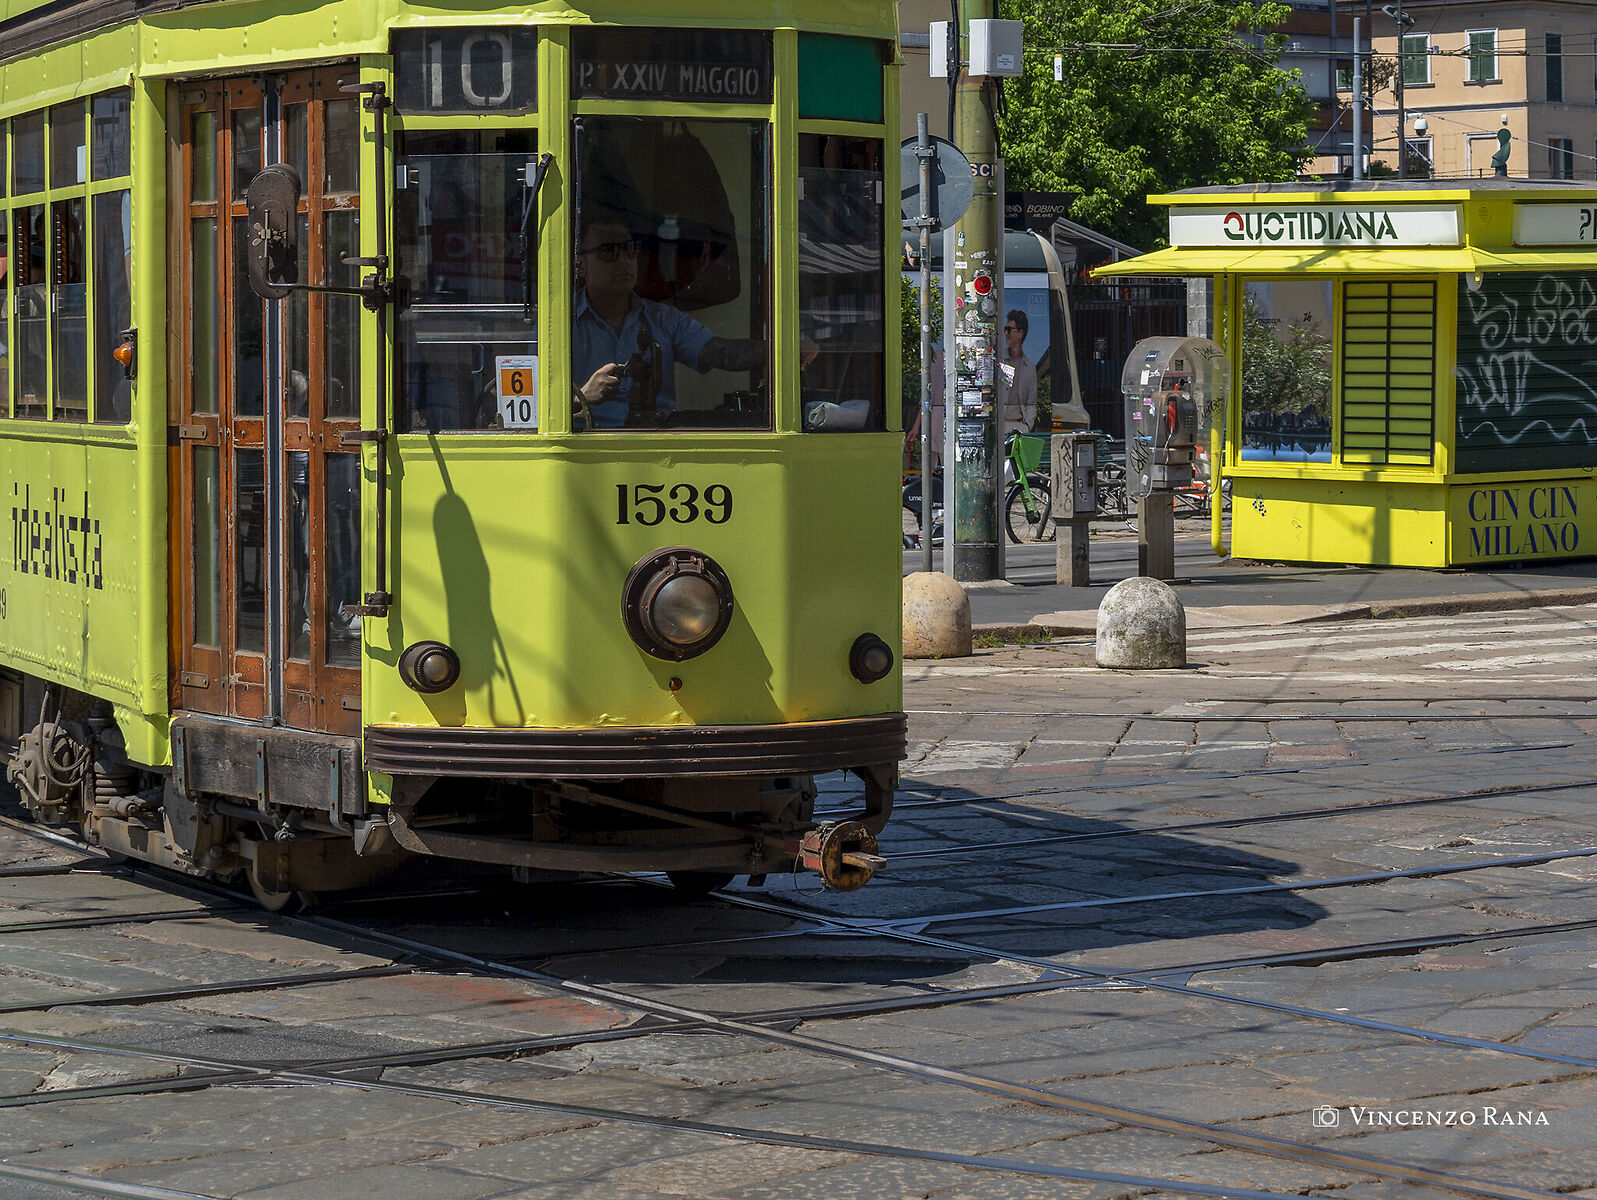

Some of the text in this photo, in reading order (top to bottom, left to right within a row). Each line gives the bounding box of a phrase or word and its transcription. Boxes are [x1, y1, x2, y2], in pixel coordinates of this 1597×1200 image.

[428, 32, 513, 107] 10
[612, 63, 667, 92] XXIV
[679, 65, 760, 96] MAGGIO
[1026, 204, 1065, 214] BOBINO
[1579, 208, 1597, 240] P
[1223, 211, 1399, 241] QUOTIDIANA
[511, 370, 524, 395] 6
[505, 399, 532, 423] 10
[615, 483, 734, 526] 1539
[1468, 486, 1579, 522] CIN CIN
[12, 482, 103, 590] idealista
[1468, 522, 1579, 557] MILANO
